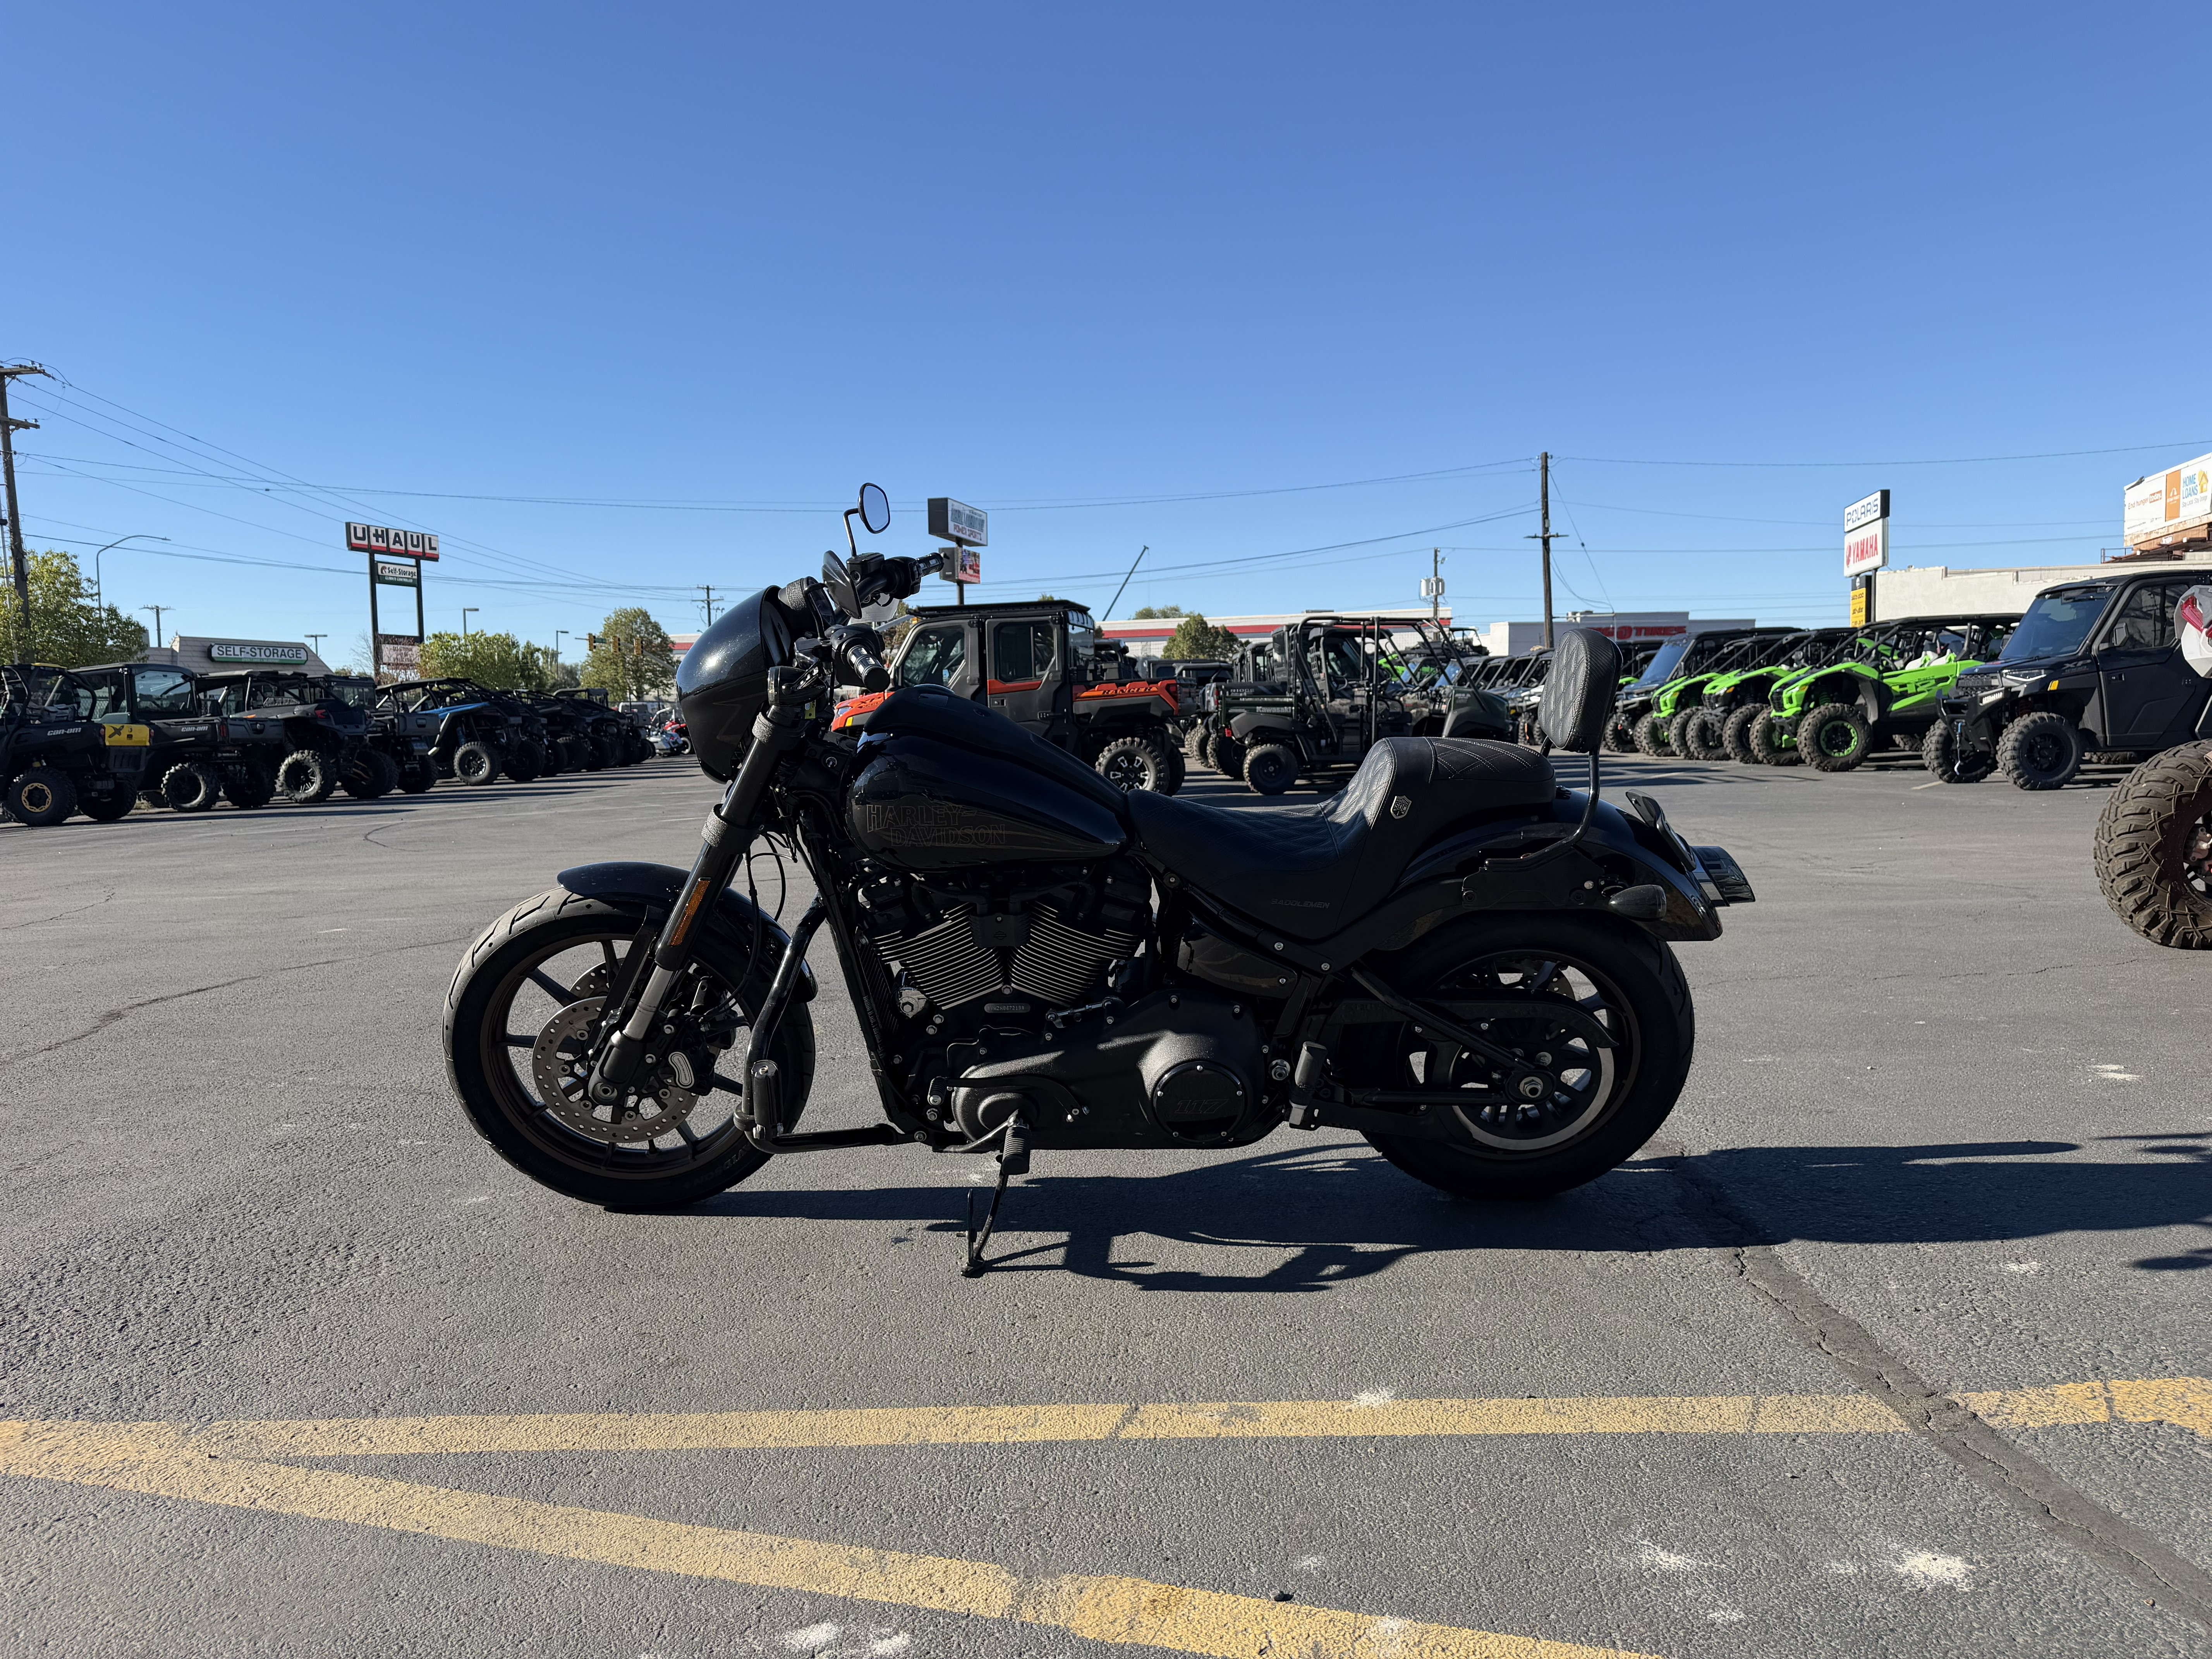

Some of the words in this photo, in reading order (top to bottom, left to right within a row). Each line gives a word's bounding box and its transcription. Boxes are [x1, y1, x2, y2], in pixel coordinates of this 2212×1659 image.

[2183, 473, 2197, 488] HOME
[2183, 484, 2198, 499] LOANS
[1846, 498, 1879, 526] POLARIS
[1852, 533, 1878, 564] YAMAHA
[387, 567, 417, 577] Self-Storage
[1633, 626, 1686, 636] TIRES
[217, 646, 302, 659] SELF-STORAGE
[47, 727, 82, 736] can-am
[890, 824, 1006, 847] DAVIDSON
[1271, 898, 1330, 909] SADDLEMEN
[1174, 1099, 1229, 1114] 117
